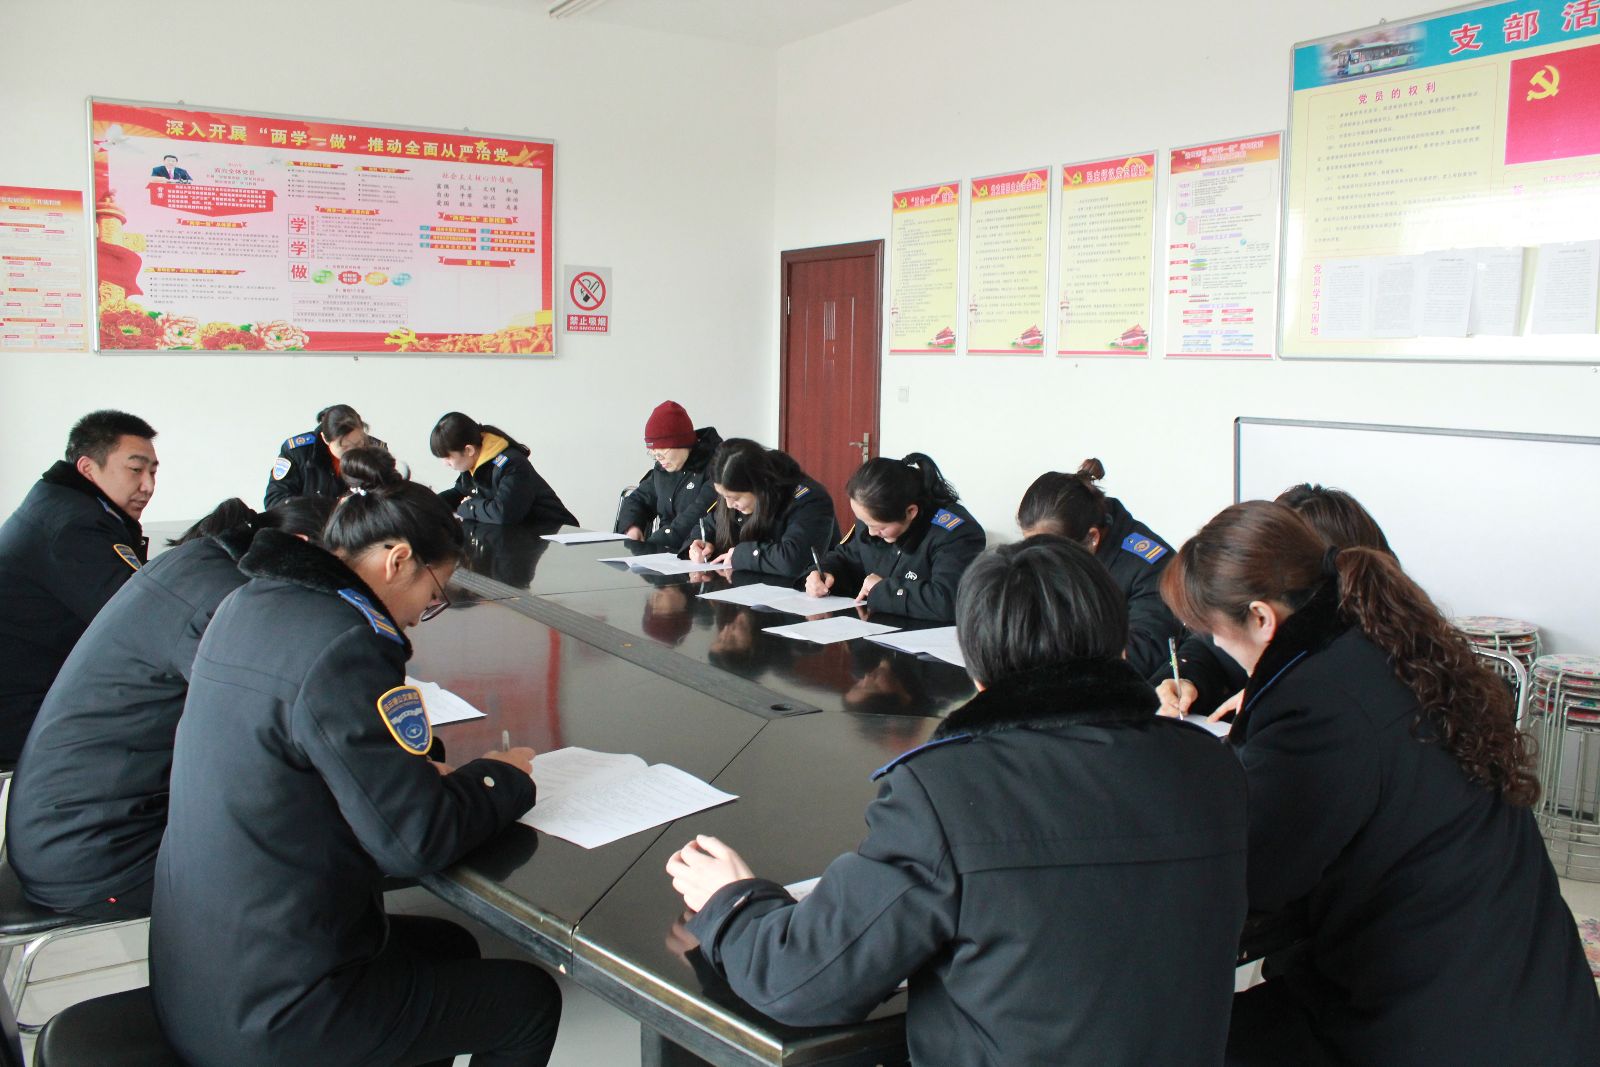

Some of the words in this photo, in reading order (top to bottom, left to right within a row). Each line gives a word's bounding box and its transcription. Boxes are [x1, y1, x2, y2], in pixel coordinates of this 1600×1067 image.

[1358, 81, 1436, 104] 党员的权利
[290, 217, 307, 233] 学
[290, 240, 307, 256] 学
[290, 264, 308, 280] 做
[569, 315, 607, 326] 禁止吸烟
